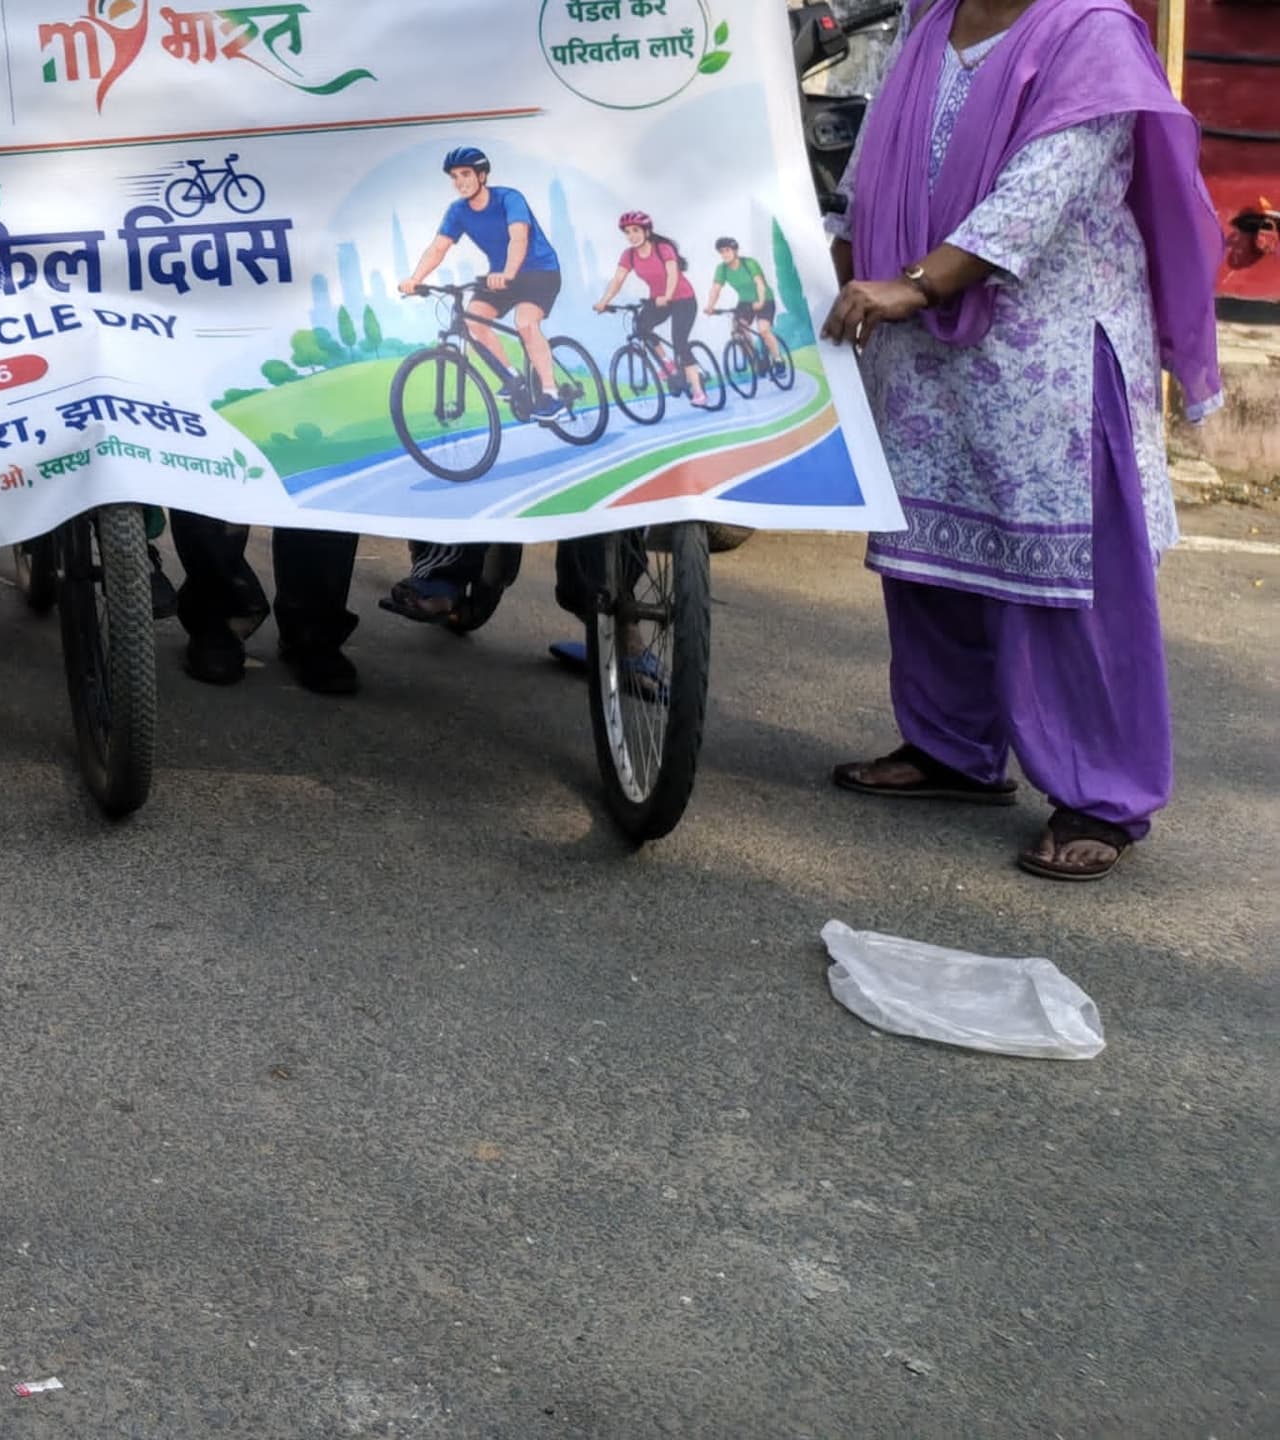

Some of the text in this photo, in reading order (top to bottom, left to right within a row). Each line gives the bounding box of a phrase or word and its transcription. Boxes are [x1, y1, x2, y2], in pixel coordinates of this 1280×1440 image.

[159, 1, 378, 96] भारत
[550, 24, 694, 67] परिवर्तन लाएँ
[118, 204, 293, 296] दिवस
[94, 307, 179, 340] DAY
[56, 394, 208, 438] झारखंड
[37, 448, 91, 480] स्वस्थ
[95, 435, 152, 464] जीवन
[159, 455, 236, 480] अपनाओ
